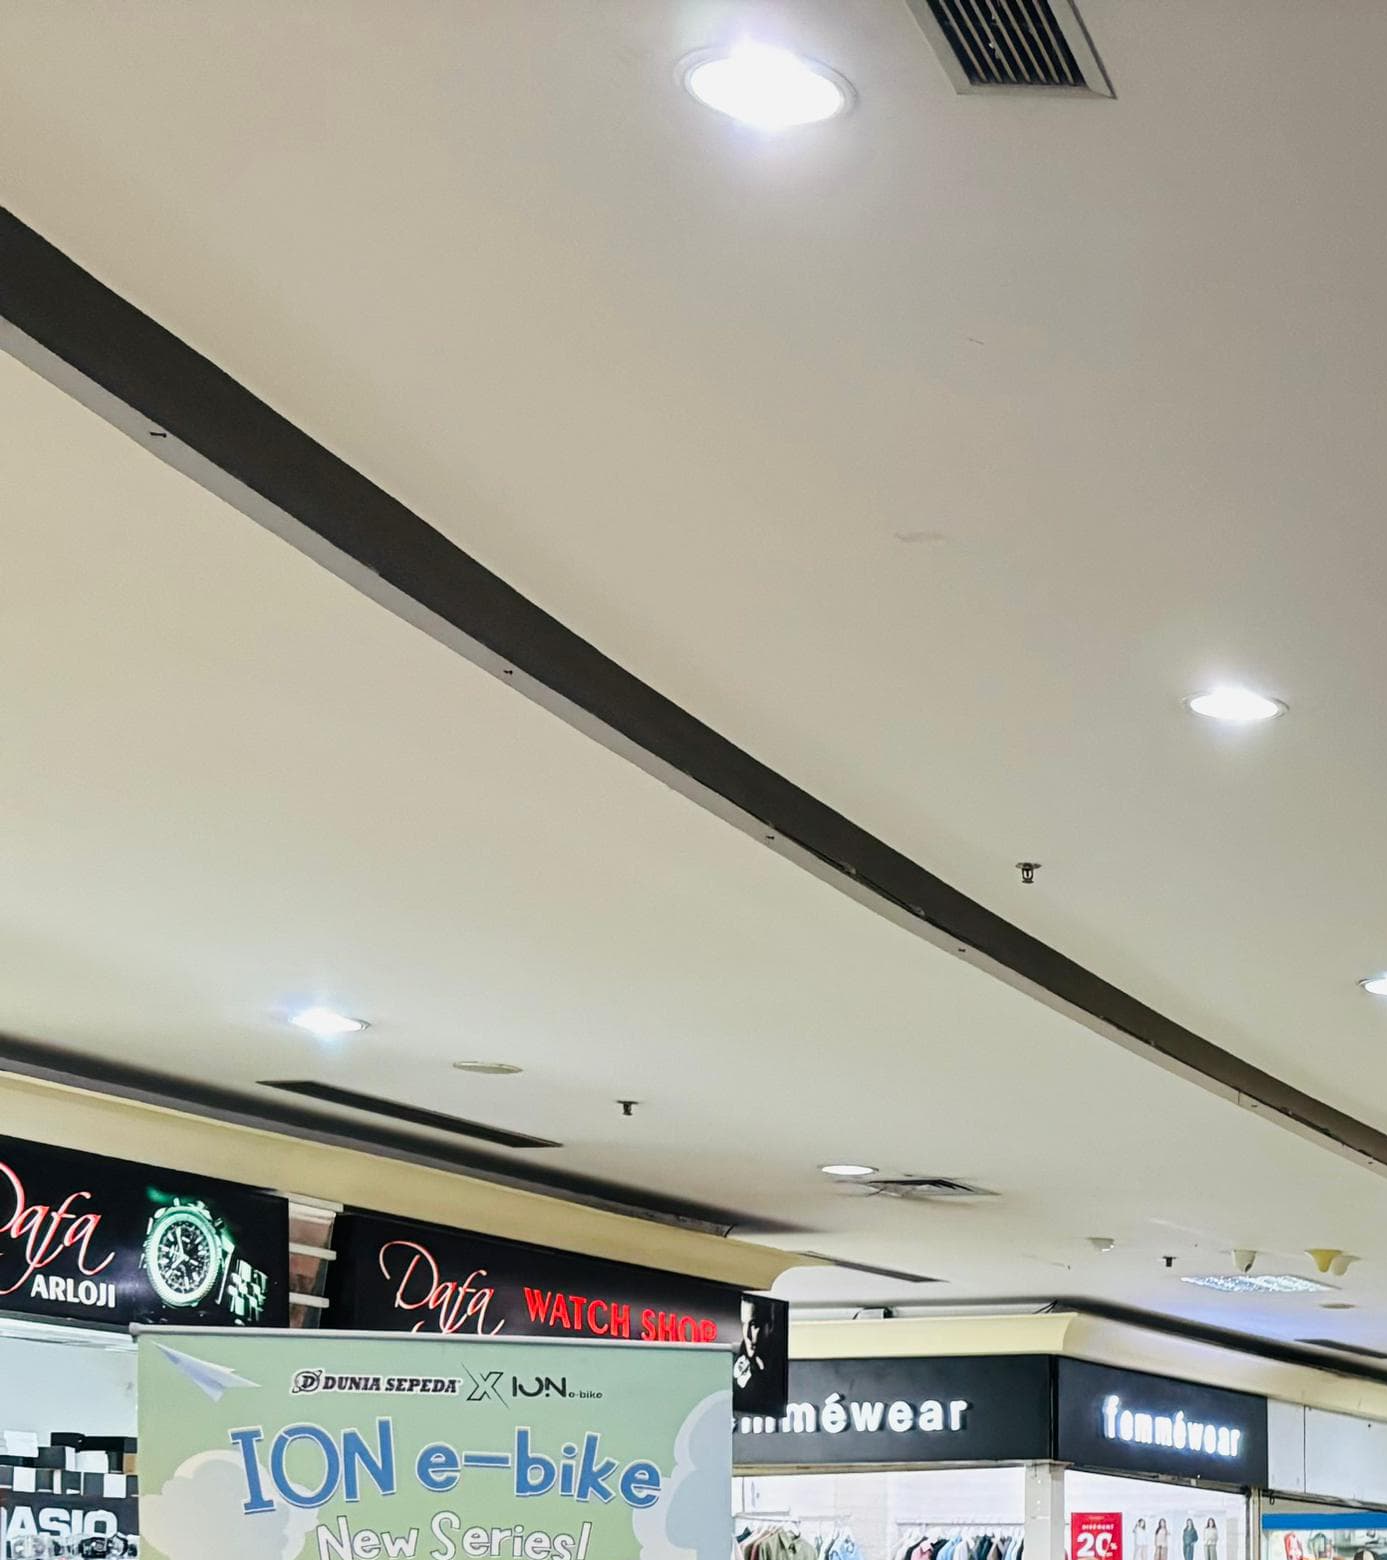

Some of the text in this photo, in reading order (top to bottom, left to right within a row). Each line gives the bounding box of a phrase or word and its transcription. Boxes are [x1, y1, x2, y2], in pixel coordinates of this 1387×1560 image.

[30, 1275, 117, 1308] ARLOJI
[379, 1240, 718, 1343] Dafa WATCH SHOP
[322, 1375, 381, 1392] DUNIA
[385, 1377, 459, 1393] SEPEDA
[512, 1376, 567, 1398] ION
[568, 1390, 603, 1399] e-bike
[227, 1416, 663, 1515] ION e-bike
[0, 1506, 118, 1540] ASIO
